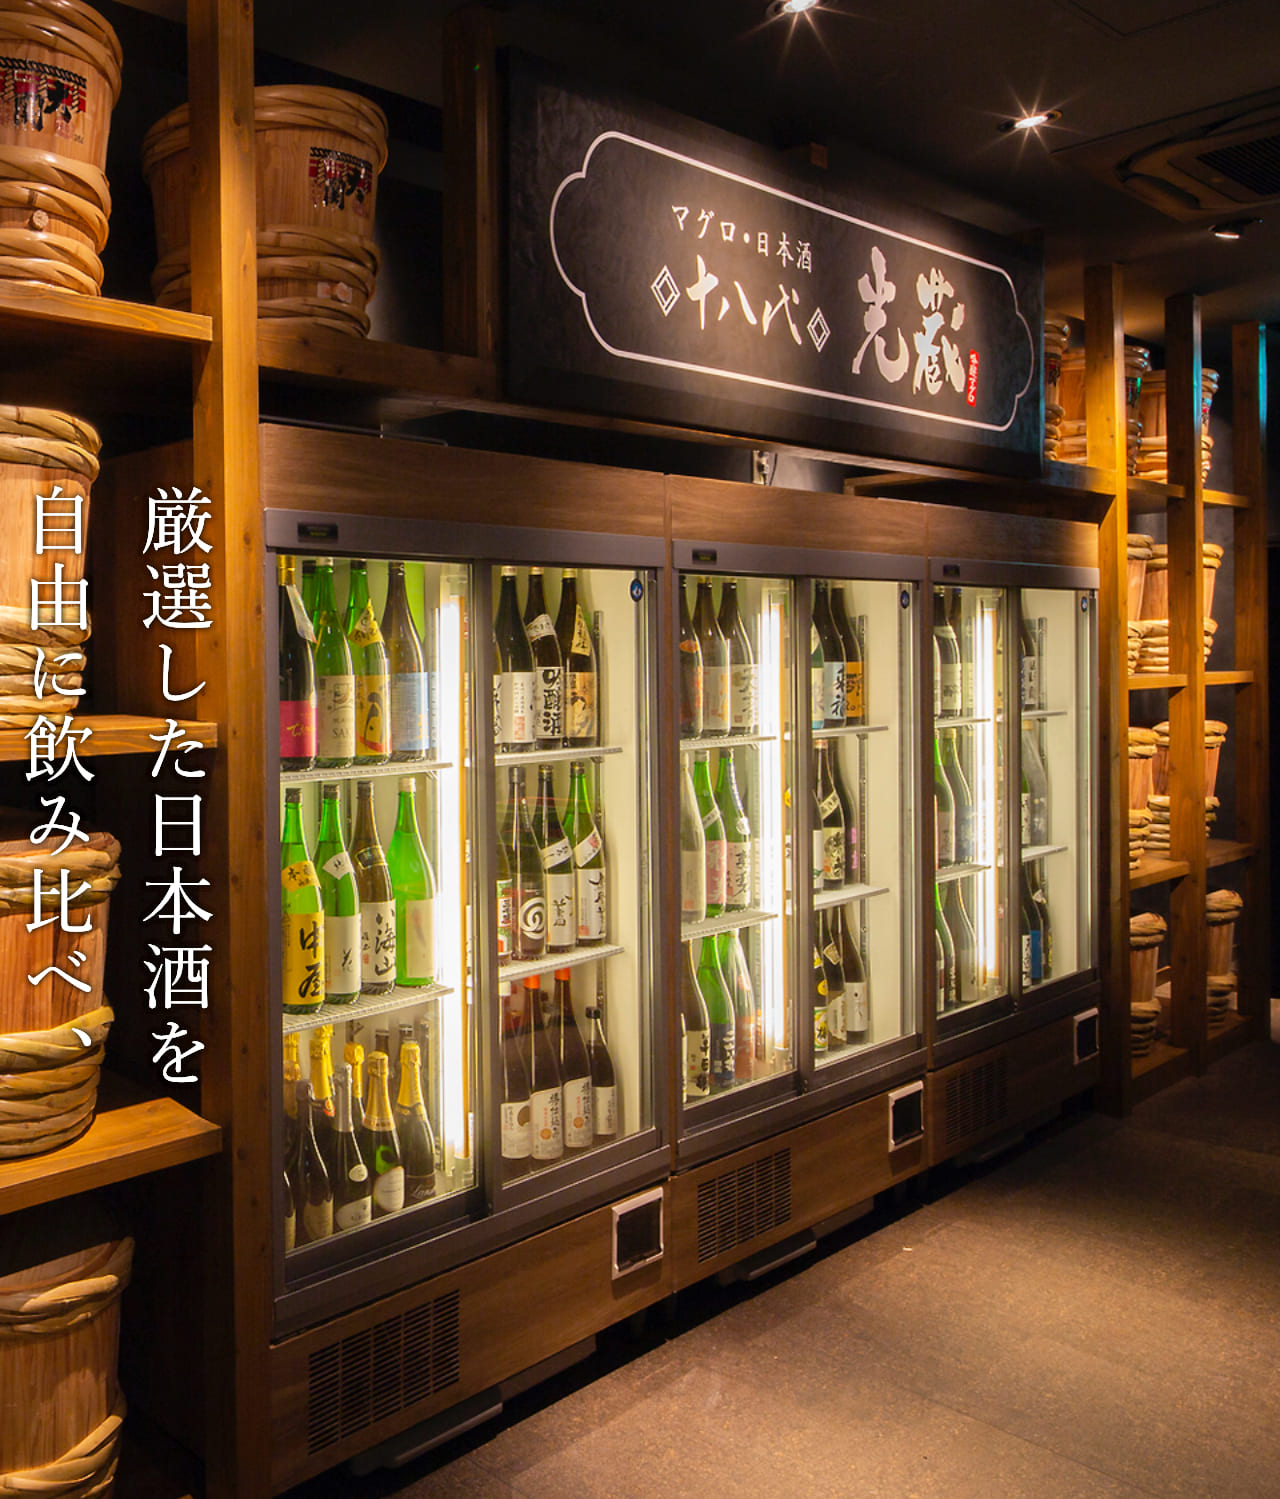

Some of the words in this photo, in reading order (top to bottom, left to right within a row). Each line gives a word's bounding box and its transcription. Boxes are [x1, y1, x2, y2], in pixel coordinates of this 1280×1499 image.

[671, 205, 813, 273] マグロ・日本酒
[686, 254, 803, 345] 十八代
[851, 246, 966, 395] 光蔵
